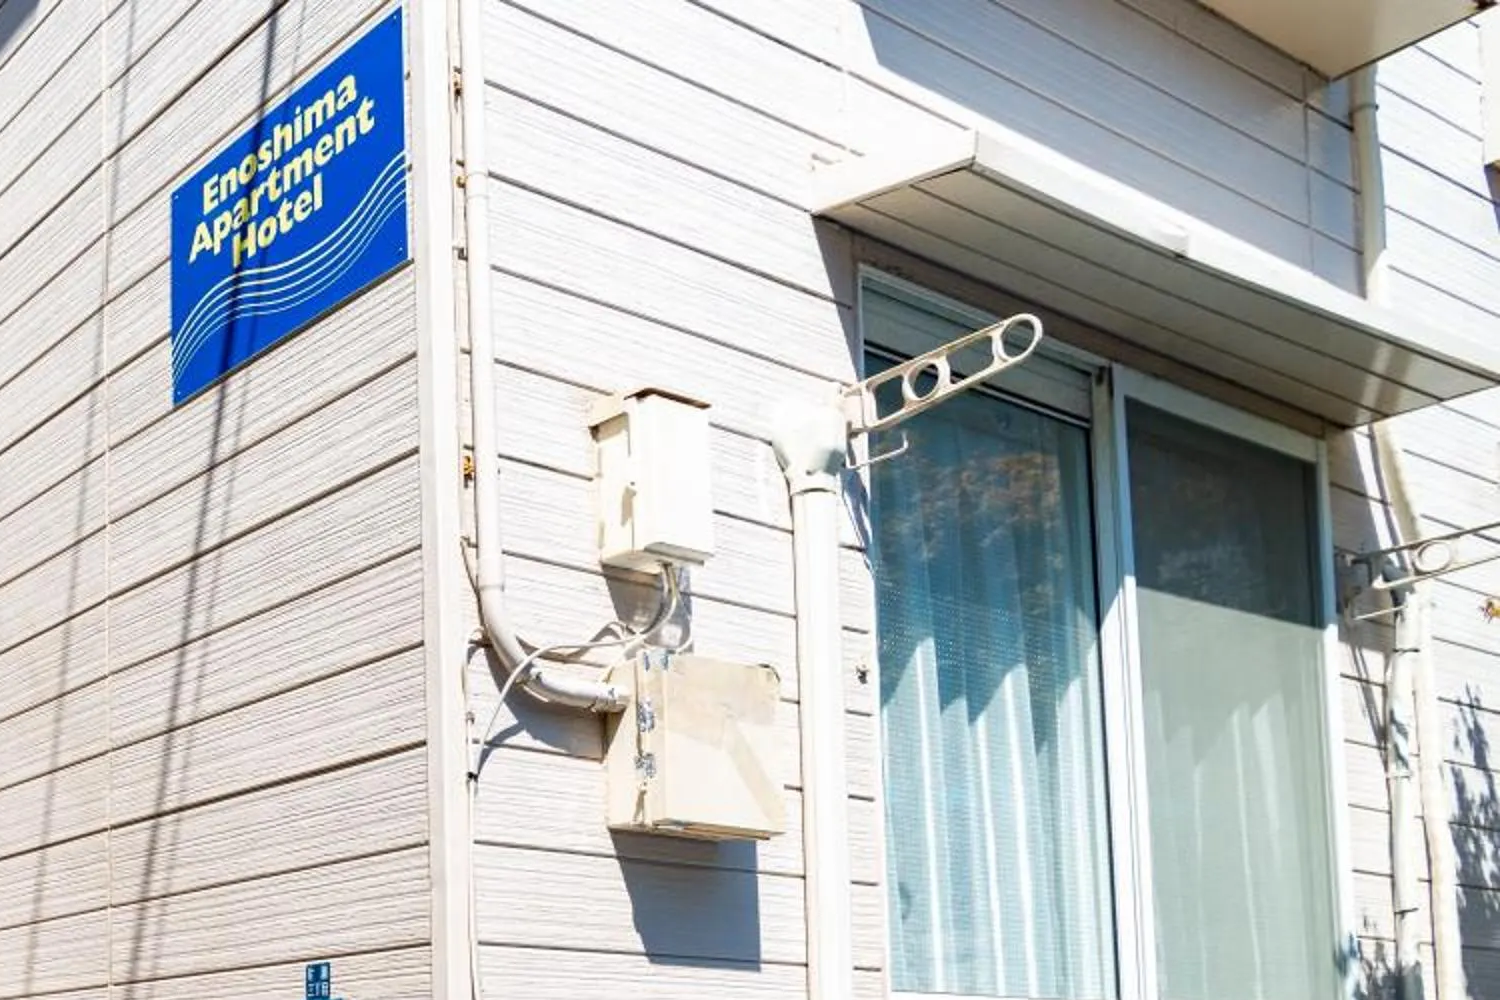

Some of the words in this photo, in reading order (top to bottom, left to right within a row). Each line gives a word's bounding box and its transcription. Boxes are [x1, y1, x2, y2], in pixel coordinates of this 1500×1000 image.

[189, 98, 375, 264] Apartment
[203, 74, 357, 215] Enoshima
[233, 173, 323, 267] Hotel
